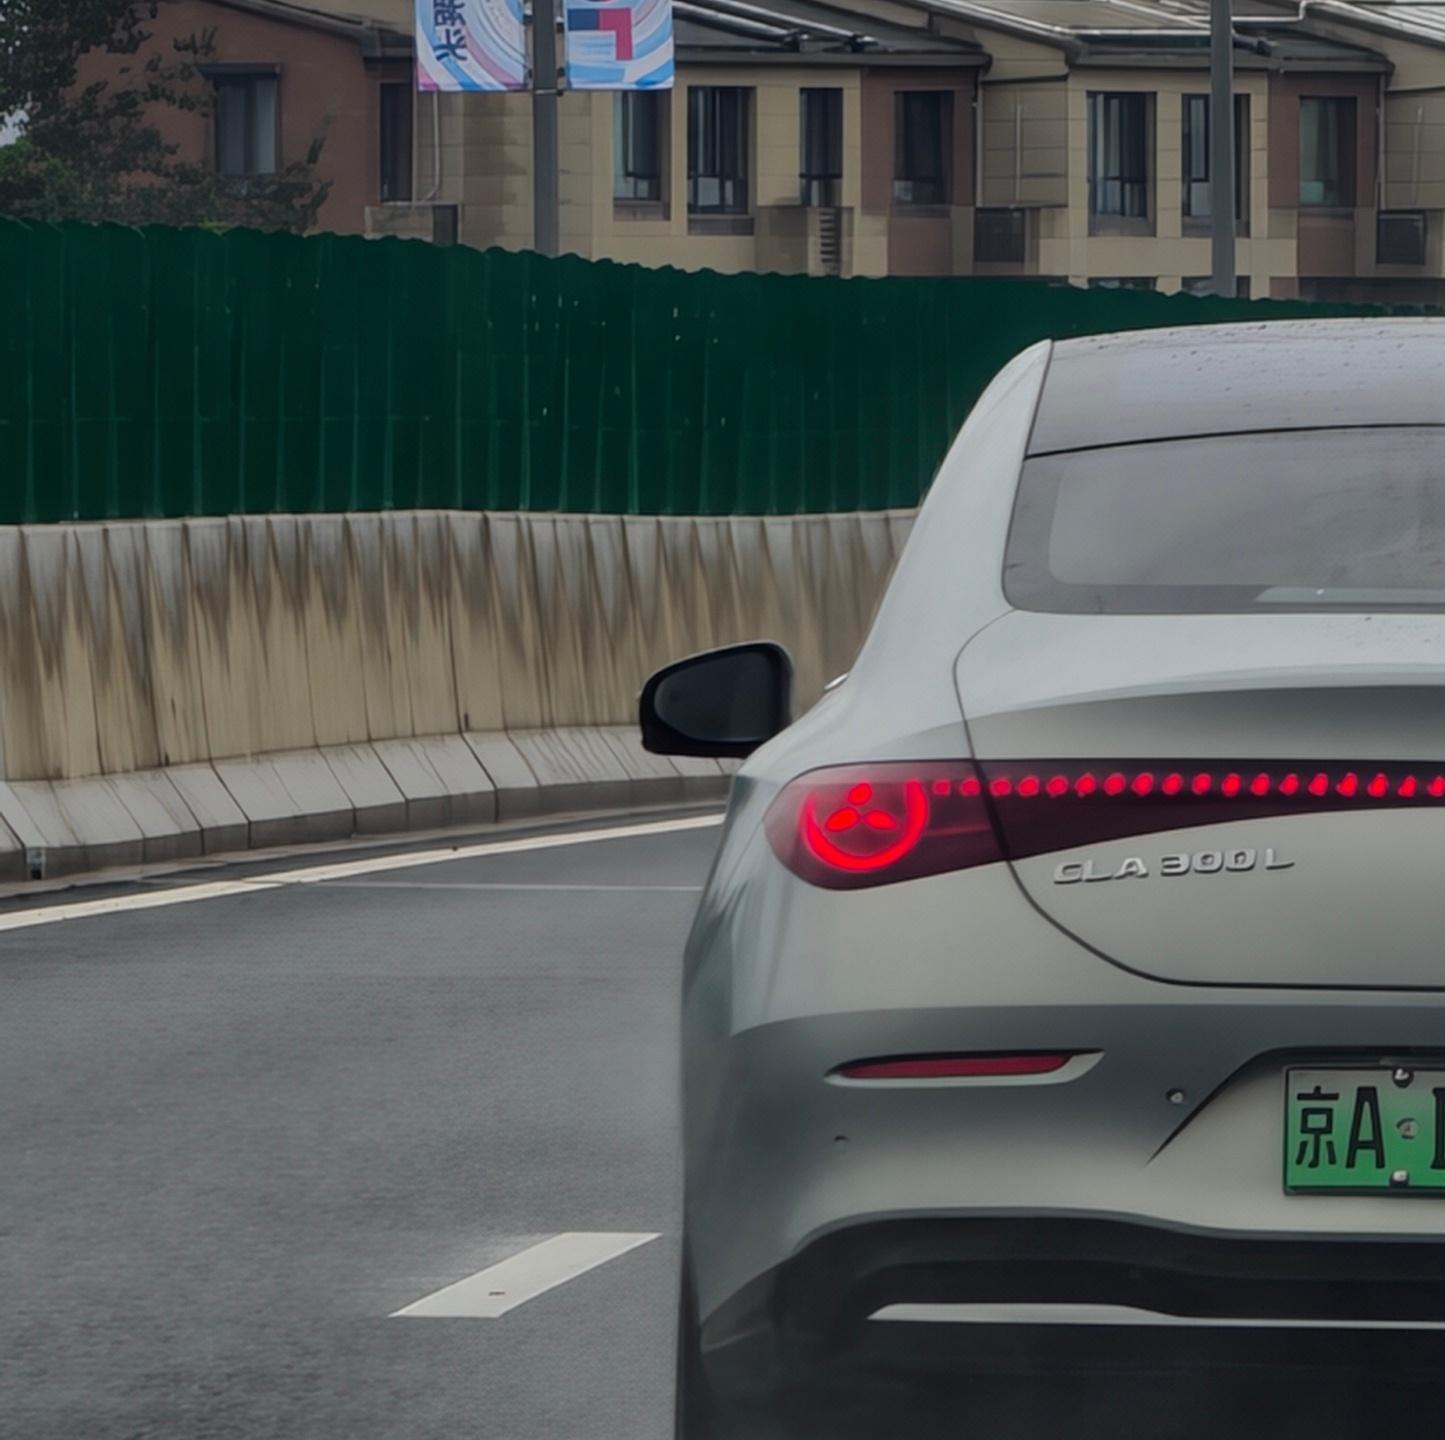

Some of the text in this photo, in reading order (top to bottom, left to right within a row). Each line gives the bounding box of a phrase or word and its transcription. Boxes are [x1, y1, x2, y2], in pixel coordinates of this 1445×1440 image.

[1053, 847, 1296, 885] CLA 300 L
[1295, 1085, 1387, 1170] 京A
